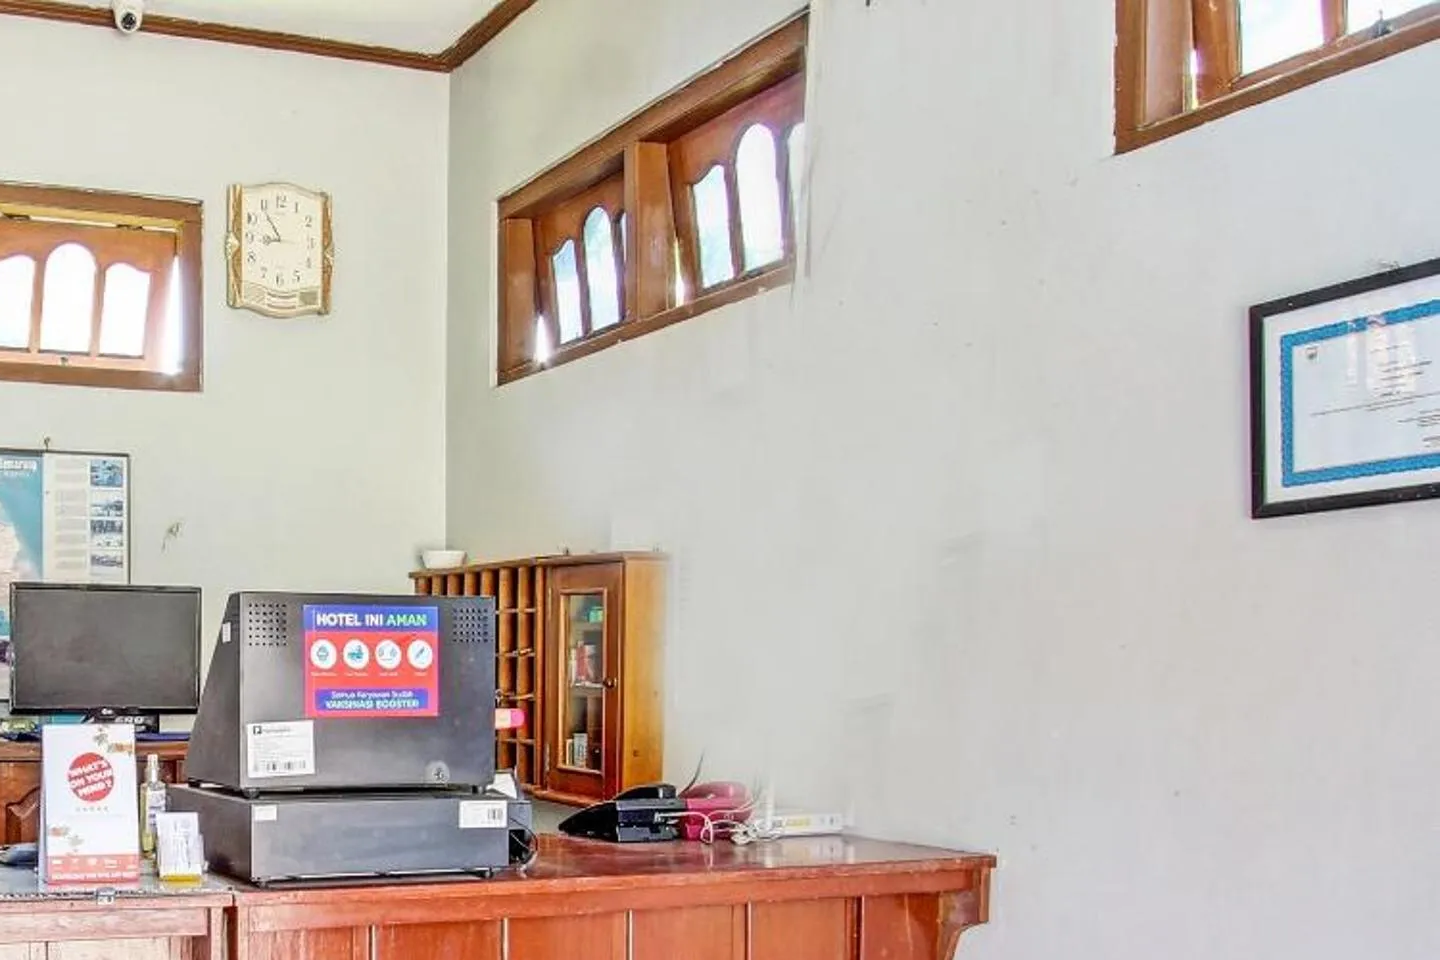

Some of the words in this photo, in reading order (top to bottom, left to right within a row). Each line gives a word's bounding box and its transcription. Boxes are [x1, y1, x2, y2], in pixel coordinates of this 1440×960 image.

[304, 215, 312, 228] 2
[316, 613, 362, 626] HOTEL
[364, 613, 384, 626] INI
[386, 614, 427, 626] AMAN
